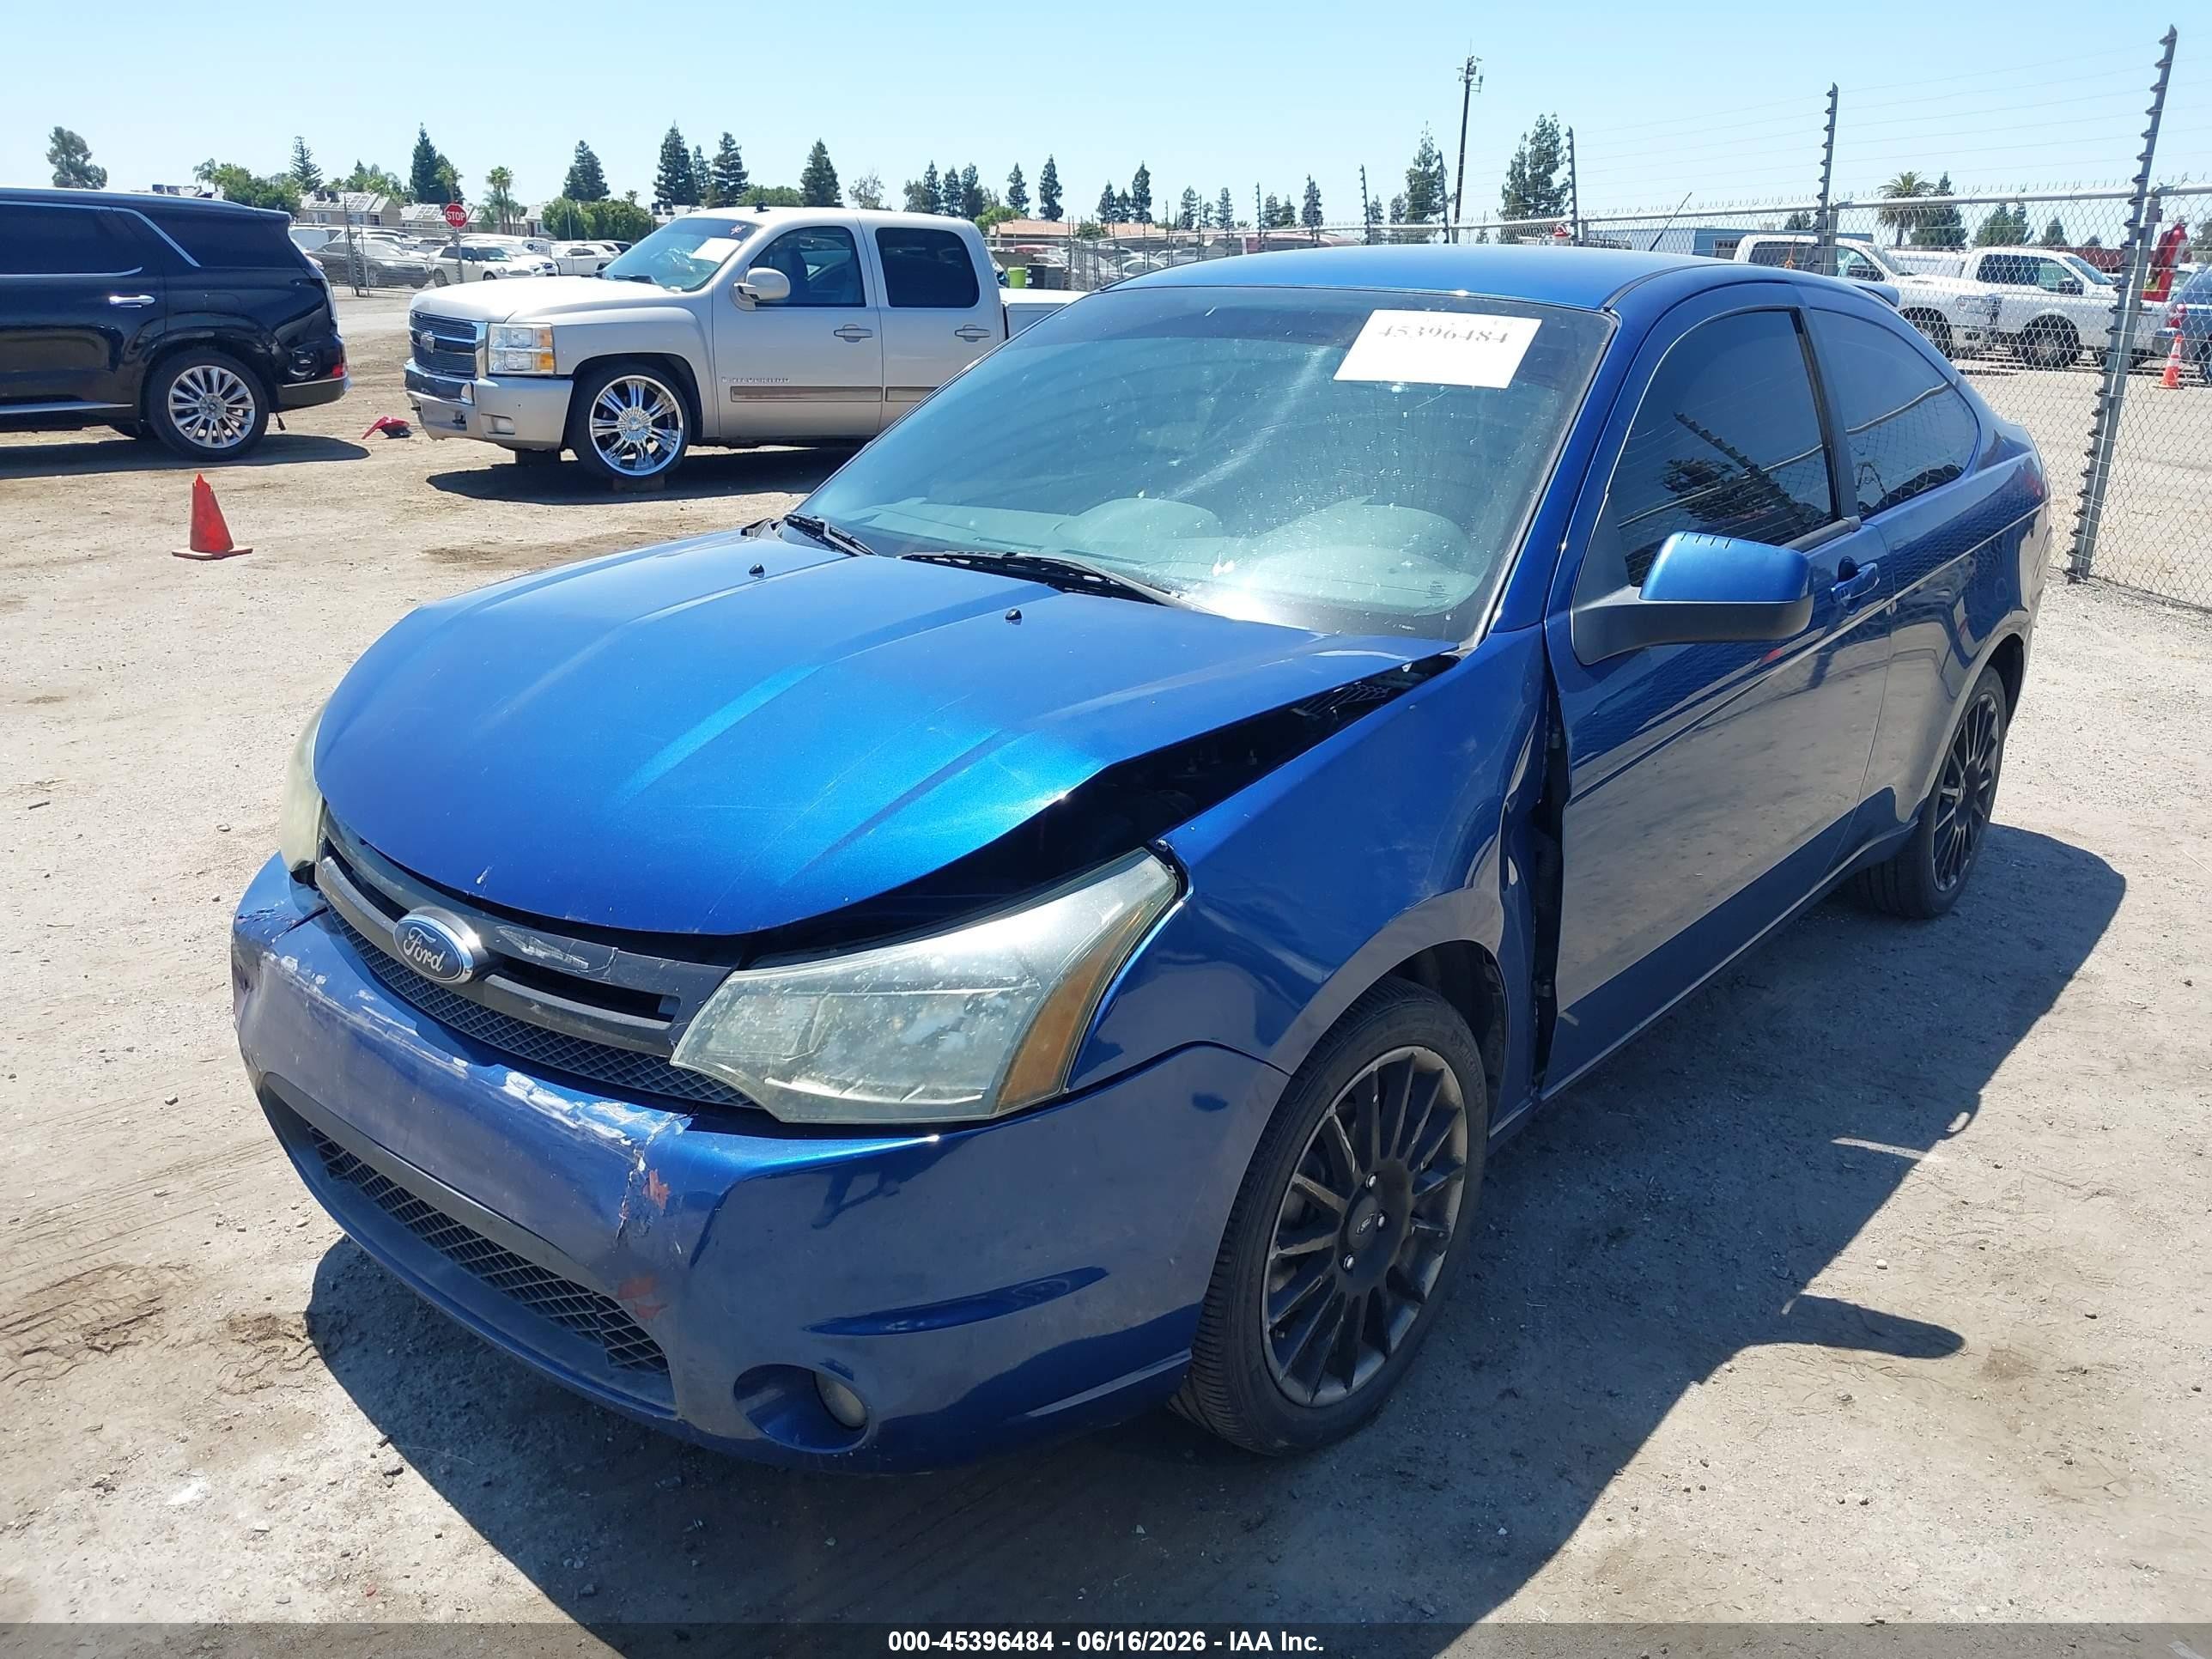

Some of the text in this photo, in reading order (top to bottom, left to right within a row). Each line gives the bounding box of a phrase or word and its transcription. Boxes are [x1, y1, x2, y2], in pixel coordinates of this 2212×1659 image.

[447, 211, 465, 221] STOP
[1379, 325, 1509, 343] 45396484
[403, 927, 447, 972] Ford
